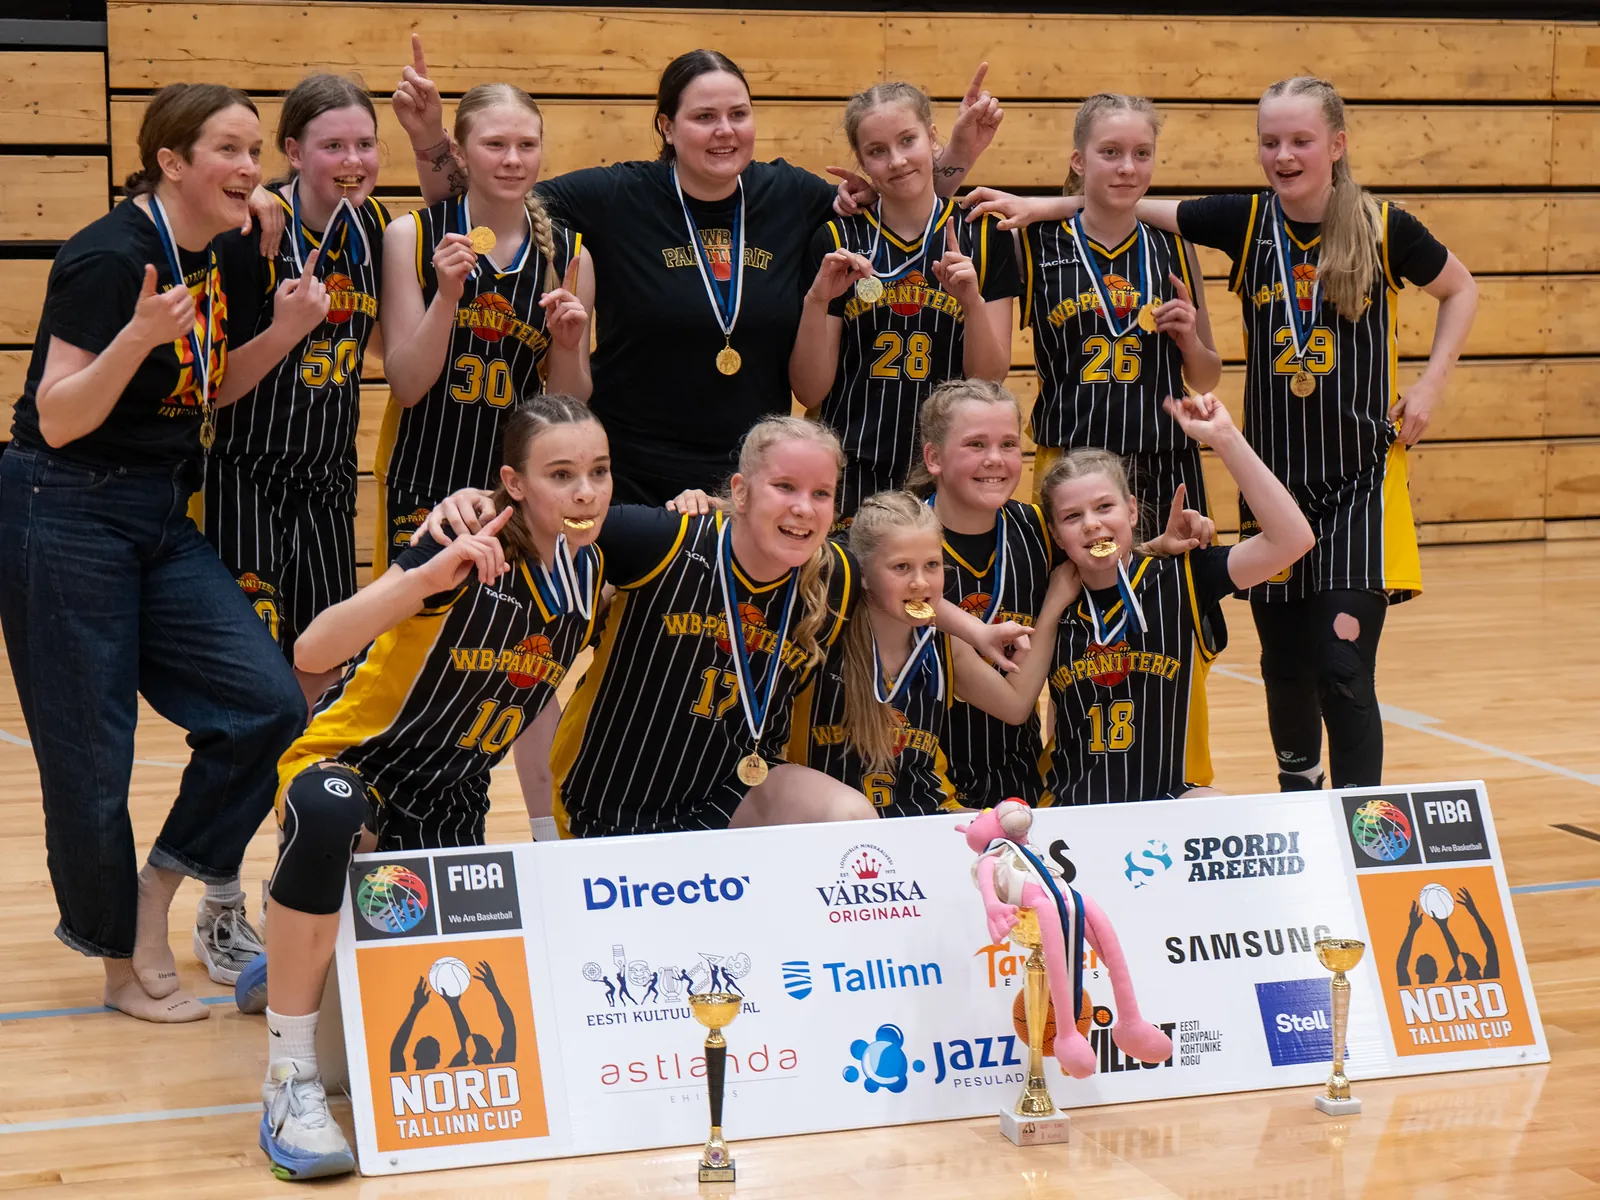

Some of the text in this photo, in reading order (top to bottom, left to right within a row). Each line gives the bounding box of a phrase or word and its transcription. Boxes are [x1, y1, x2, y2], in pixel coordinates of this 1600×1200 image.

[698, 228, 732, 246] WB
[1039, 257, 1081, 268] TACKLA
[300, 338, 359, 389] 50
[869, 330, 932, 381] 28
[1080, 335, 1143, 384] 26
[1273, 325, 1337, 376] 29
[449, 352, 515, 410] 30
[1050, 651, 1182, 693] WB-PANTTERIT
[689, 665, 742, 721] 17
[456, 697, 526, 756] 10
[1085, 698, 1136, 755] 18
[861, 770, 897, 808] 6
[1423, 798, 1472, 825] FIBA
[1184, 831, 1299, 862] SPORDI
[1428, 842, 1483, 854] We Are Basketball
[447, 862, 505, 892] FIBA
[1188, 855, 1306, 883] AREENID
[815, 880, 928, 907] VÄRSKA
[448, 911, 513, 924] We Are Basketball
[829, 905, 922, 923] ORIGINAAL
[1165, 924, 1332, 964] SAMSUNG
[822, 958, 943, 993] Tallinn
[1398, 982, 1509, 1025] NORD
[587, 1012, 628, 1027] EESTI
[1180, 1020, 1200, 1031] EESTI
[1275, 1010, 1330, 1033] Stell
[1408, 1020, 1513, 1045] TALLINN CUP
[1180, 1030, 1224, 1043] KORVPALLI-
[1180, 1041, 1222, 1055] KOHTUNIKE
[1180, 1055, 1201, 1067] KOGU
[390, 1066, 521, 1117] NORD
[953, 1072, 1026, 1089] PESULAD
[396, 1109, 523, 1140] TALLINN CUP
